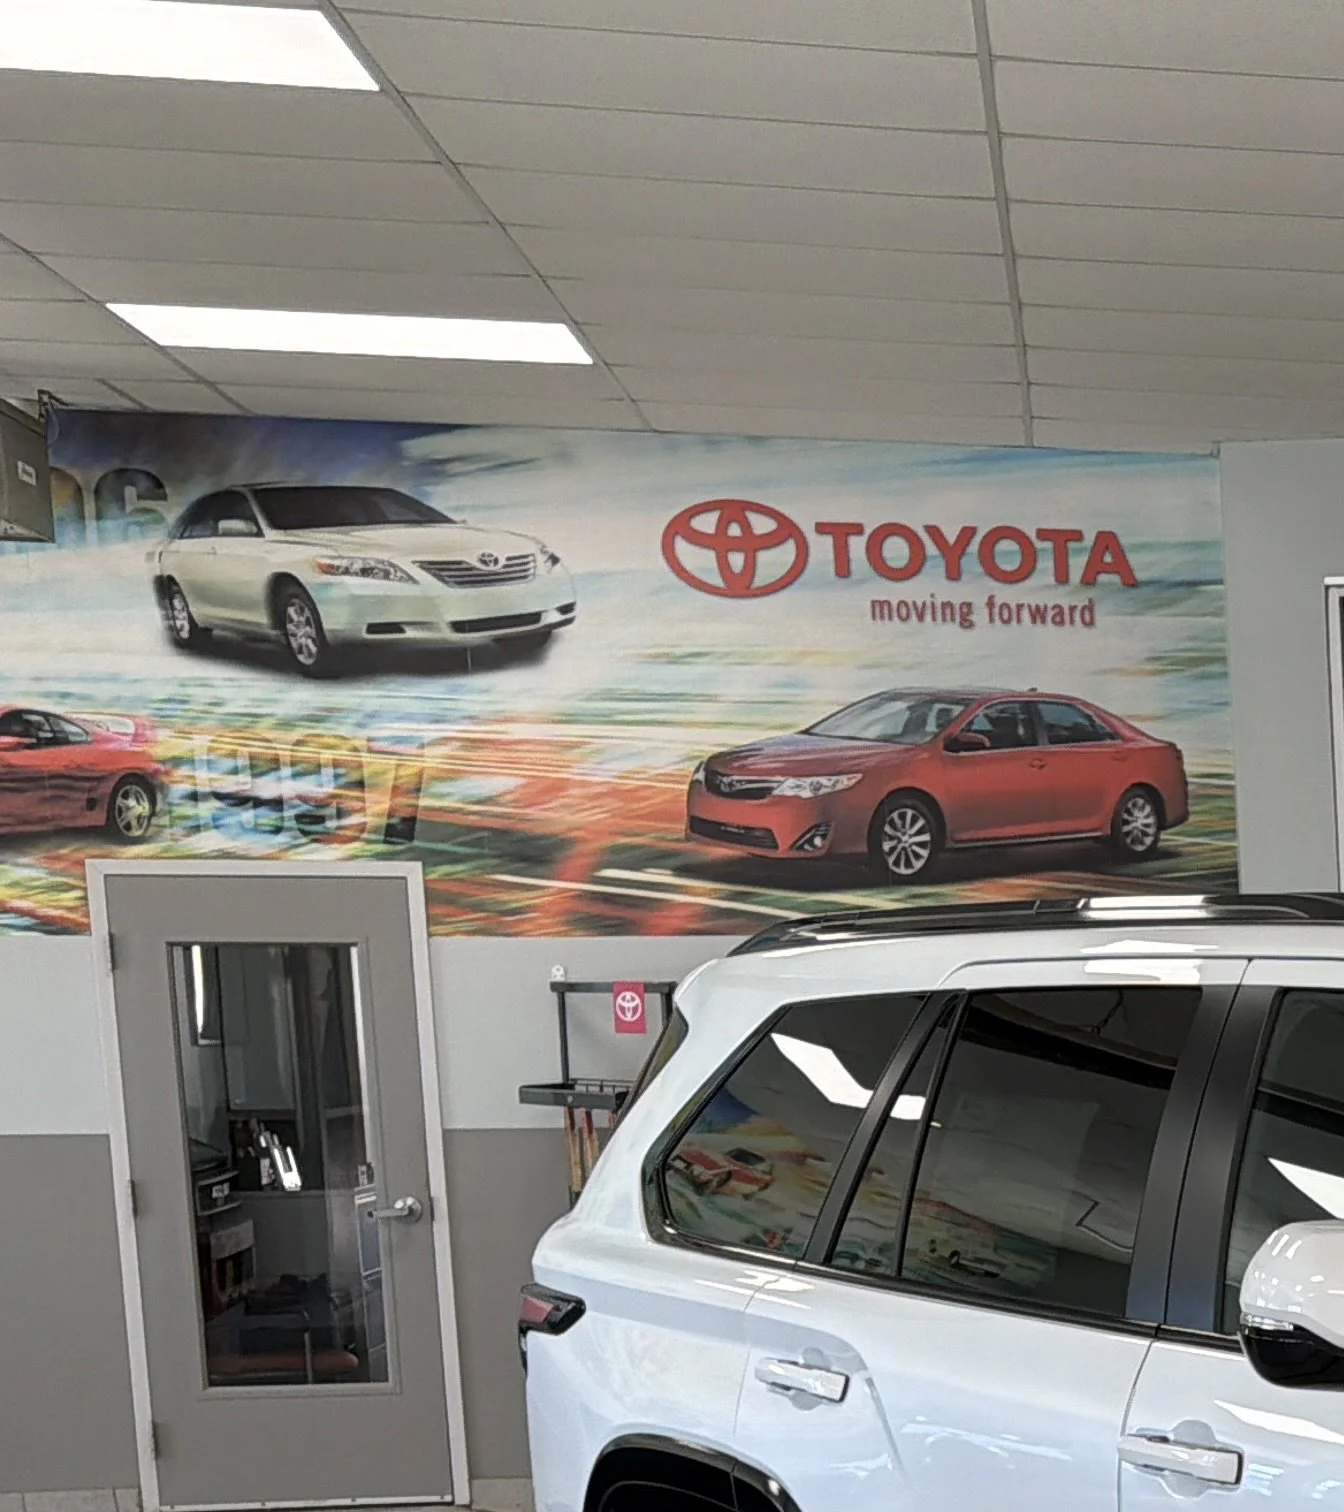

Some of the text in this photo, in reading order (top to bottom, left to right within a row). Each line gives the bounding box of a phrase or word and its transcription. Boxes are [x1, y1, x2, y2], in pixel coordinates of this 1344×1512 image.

[815, 521, 1138, 587] TOYOTA
[871, 594, 1095, 629] moving forward
